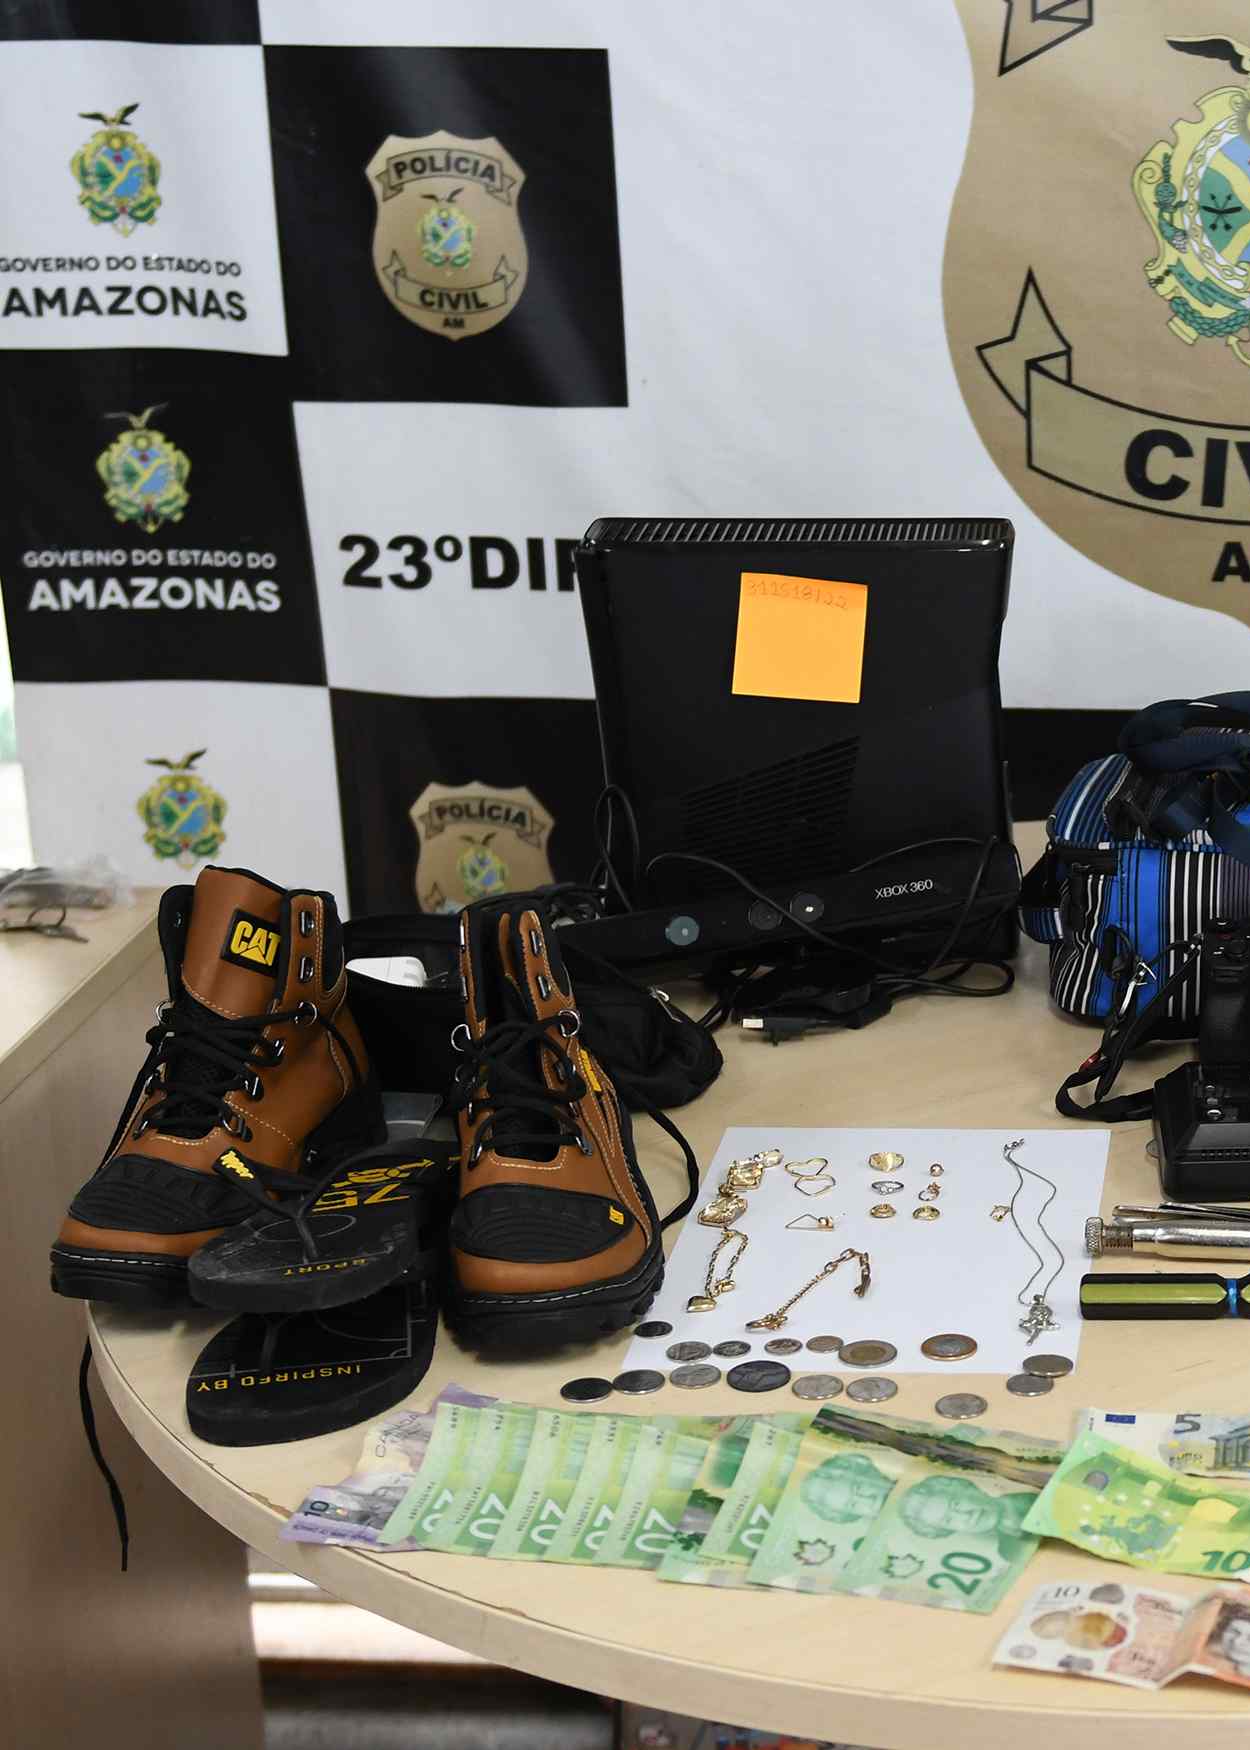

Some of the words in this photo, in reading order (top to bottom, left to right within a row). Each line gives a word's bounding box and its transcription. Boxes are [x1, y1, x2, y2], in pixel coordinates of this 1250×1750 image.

[393, 151, 496, 183] POLÍCIA
[0, 257, 99, 272] GOVERNO
[106, 256, 136, 271] DO
[143, 256, 211, 274] ESTADO
[216, 262, 241, 277] DO
[2, 286, 247, 321] AMAZONAS
[419, 289, 488, 310] CIVIL
[443, 318, 464, 328] AM
[23, 550, 127, 568] GOVERNO
[131, 549, 162, 566] DO
[167, 549, 242, 568] ESTADO
[247, 552, 276, 569] DO
[28, 577, 281, 612] AMAZONAS
[434, 800, 527, 827] POLÍCIA
[875, 885, 908, 900] XBOX
[910, 879, 933, 892] 360
[231, 920, 283, 967] CAT
[1173, 1413, 1202, 1435] 5
[927, 1551, 993, 1596] 20
